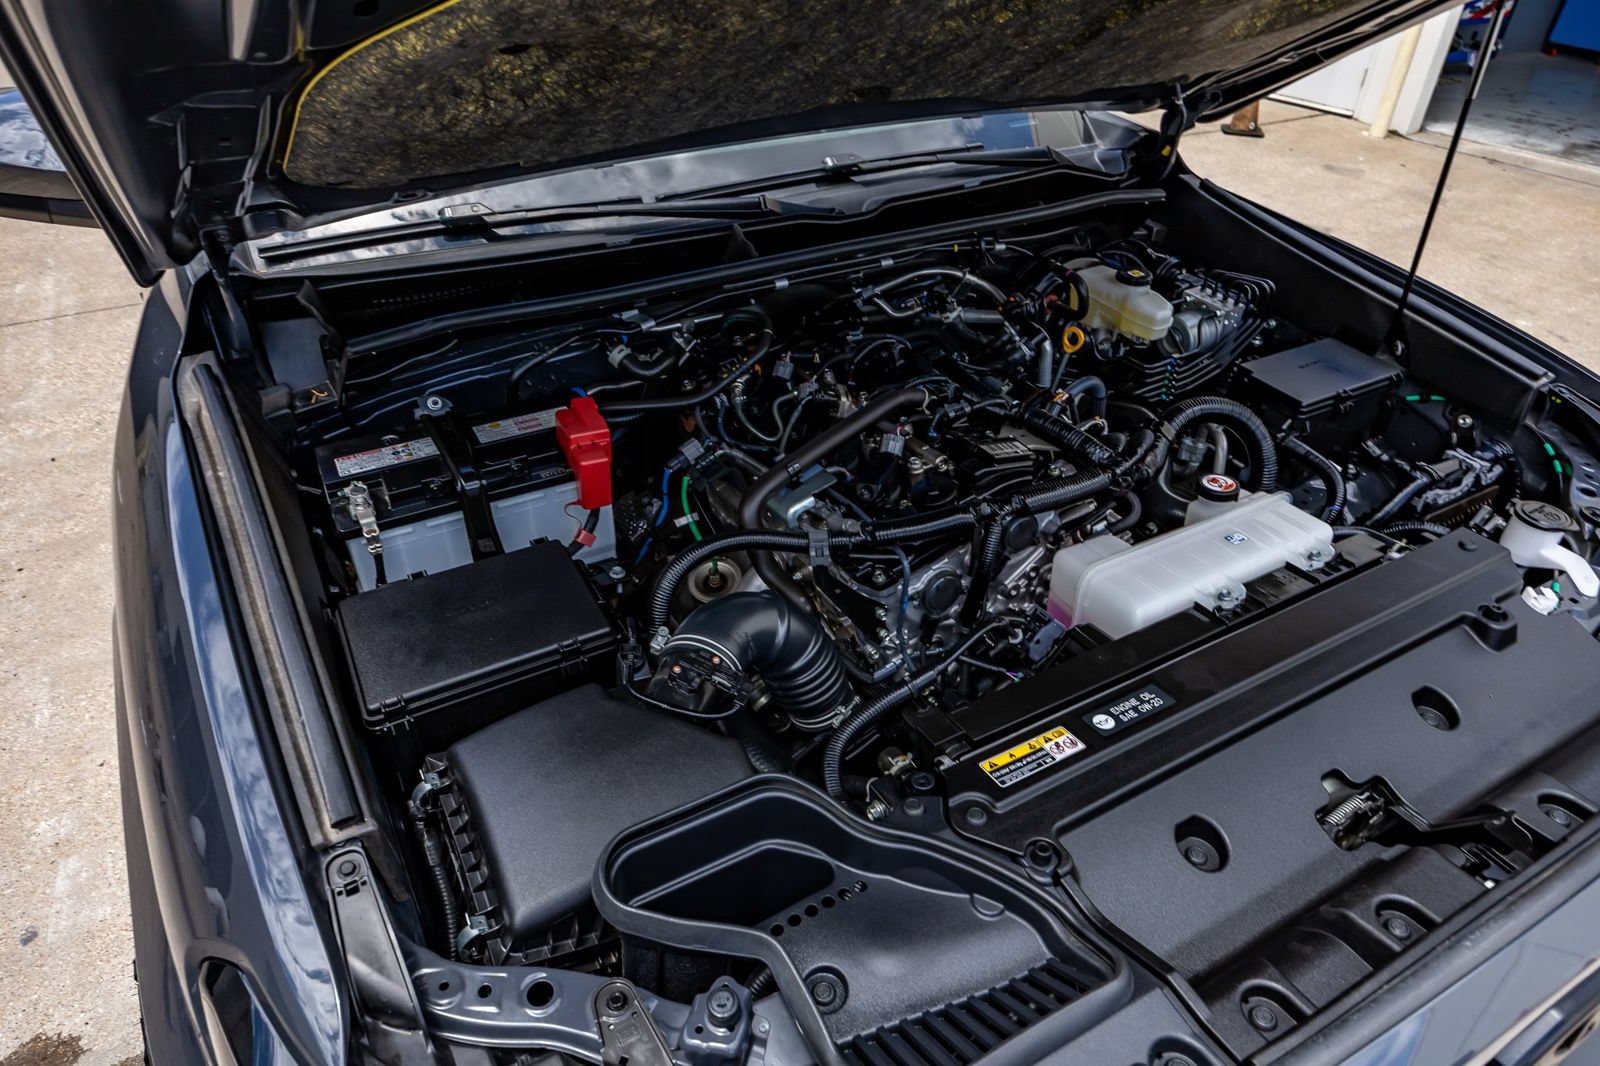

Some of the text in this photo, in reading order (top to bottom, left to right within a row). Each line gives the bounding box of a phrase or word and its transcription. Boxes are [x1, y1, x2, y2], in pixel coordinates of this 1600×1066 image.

[1109, 691, 1156, 715] ENGINE OIL
[1118, 697, 1164, 722] SAE 0W-20
